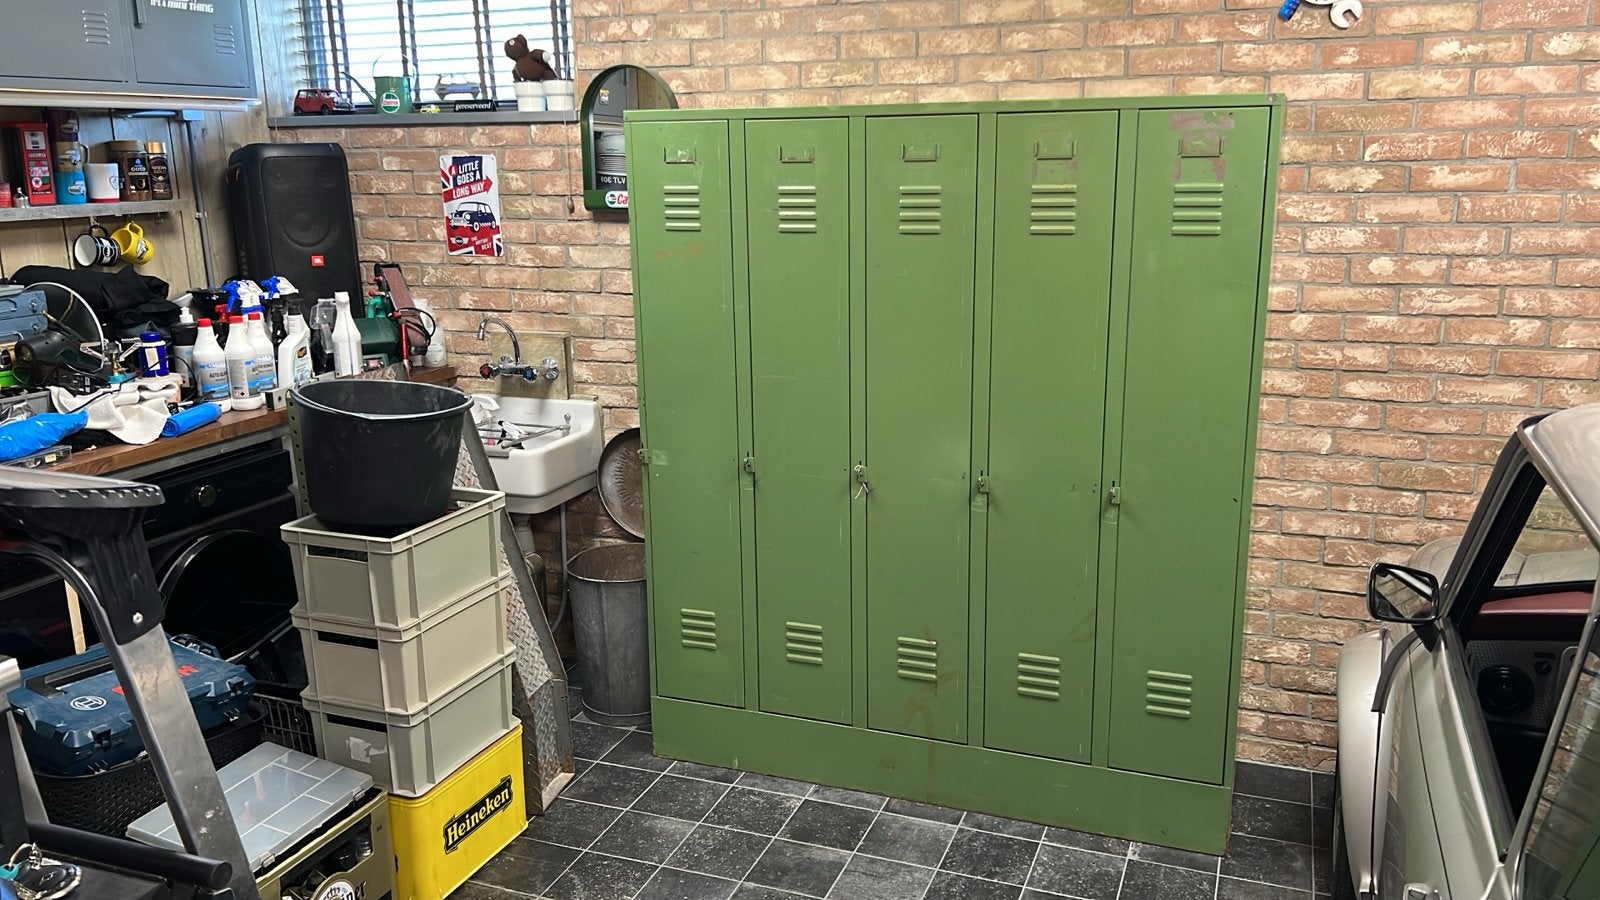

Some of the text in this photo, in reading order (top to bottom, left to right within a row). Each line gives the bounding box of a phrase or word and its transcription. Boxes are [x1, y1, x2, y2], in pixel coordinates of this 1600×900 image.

[189, 2, 214, 13] THING
[451, 160, 479, 175] A LITTLE
[456, 170, 480, 185] GOES A
[452, 182, 485, 199] LONG WAY
[447, 788, 509, 846] Heineken
